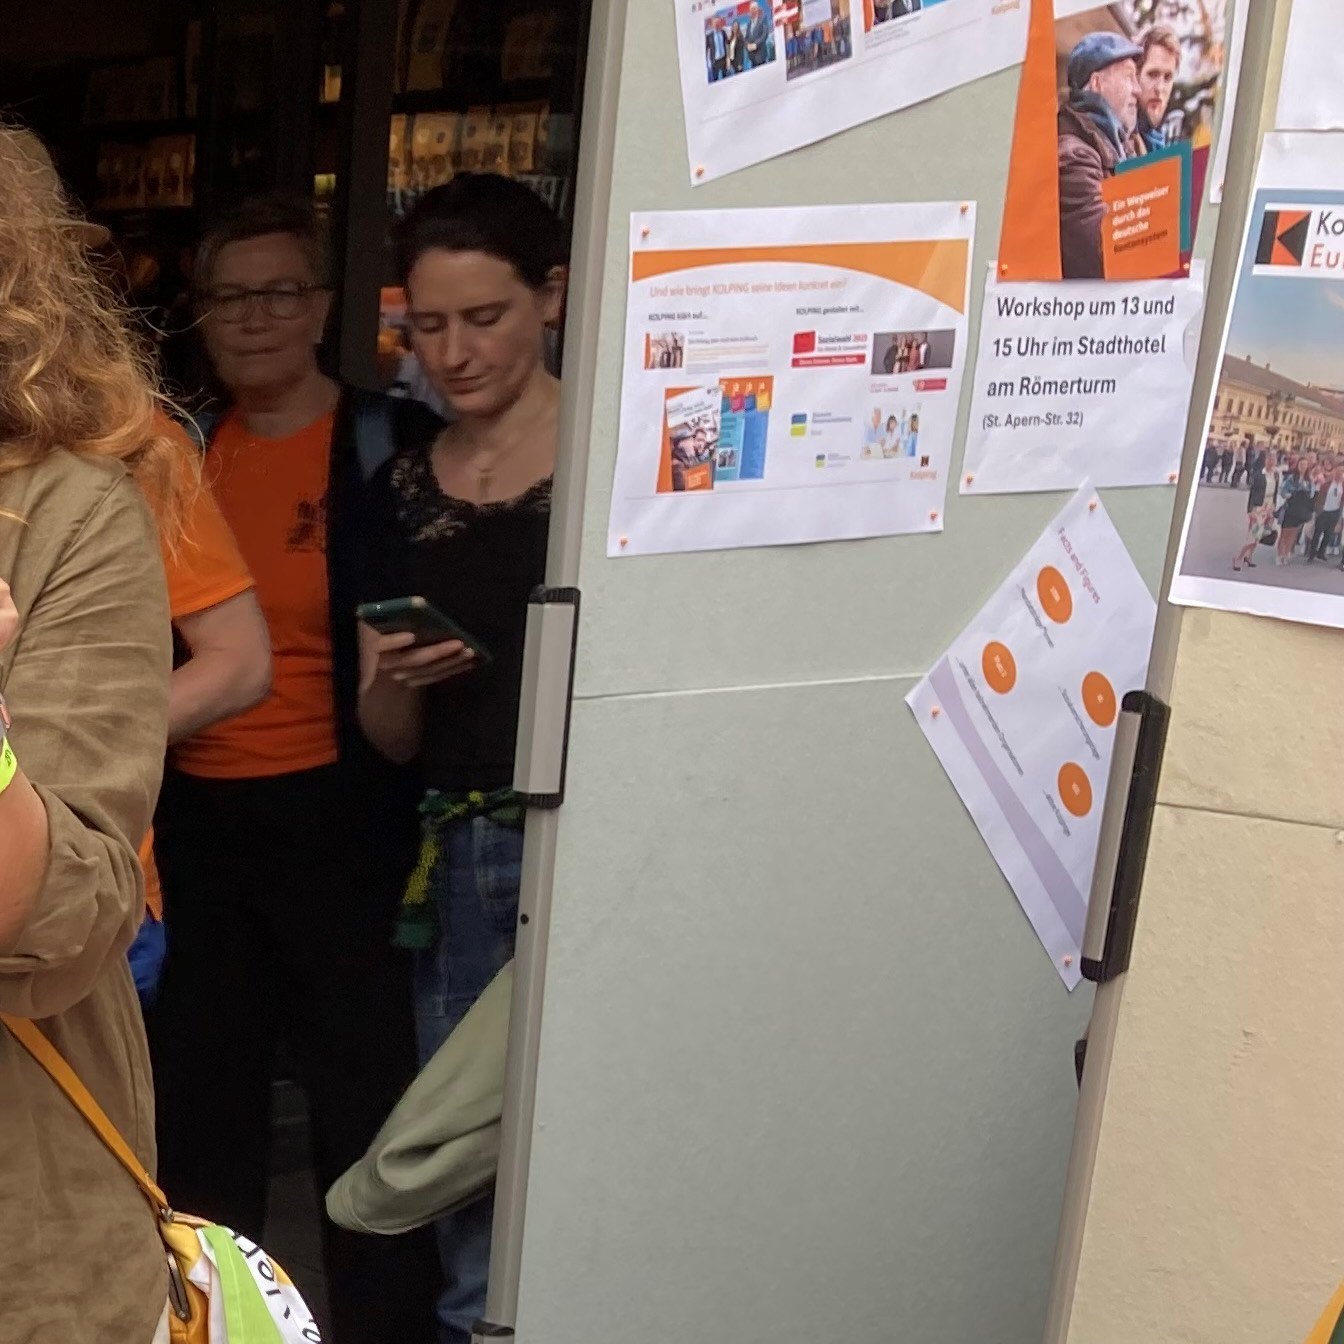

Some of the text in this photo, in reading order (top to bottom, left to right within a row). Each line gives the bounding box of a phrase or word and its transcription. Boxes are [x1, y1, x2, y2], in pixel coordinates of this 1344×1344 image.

[1113, 205, 1151, 226] durch das
[1113, 220, 1149, 241] deutsche
[997, 296, 1175, 320] Workshop um 13 und
[993, 335, 1166, 357] 15 Uhr im Stadthotel
[987, 376, 1116, 397] am Römerturm
[983, 411, 1084, 430] (St. Apern-Str. 32)
